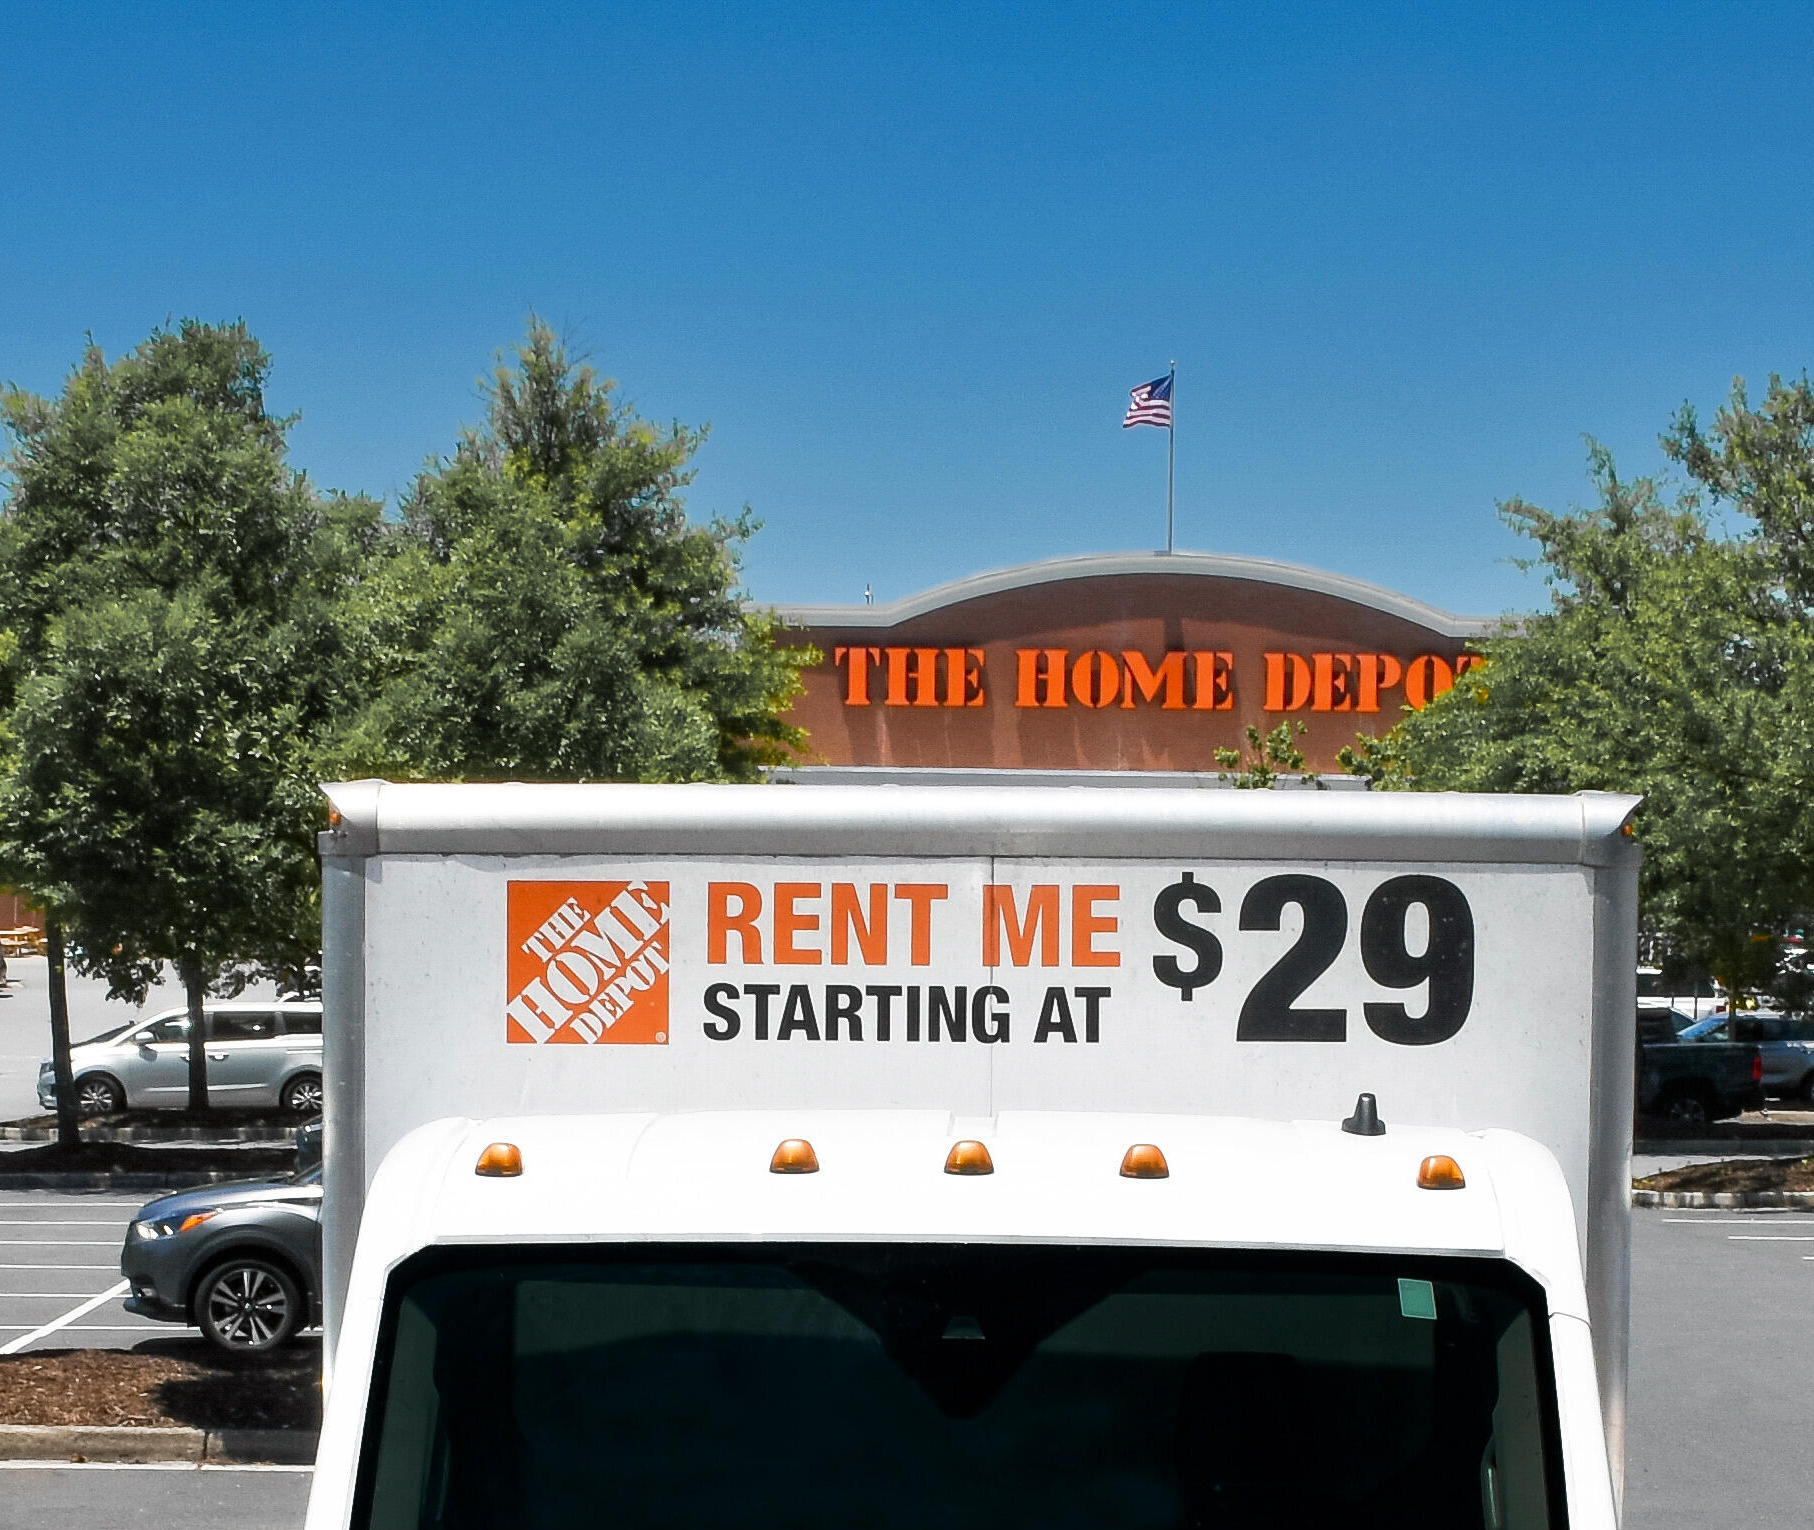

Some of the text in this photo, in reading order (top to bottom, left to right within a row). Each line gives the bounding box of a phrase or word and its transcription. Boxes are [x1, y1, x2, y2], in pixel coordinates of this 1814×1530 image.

[834, 646, 986, 708] THE
[1014, 648, 1234, 711] HOME
[506, 881, 670, 1044] HOME
[521, 897, 592, 963] THE
[706, 882, 1121, 968] RENT ME
[1152, 871, 1475, 1046] $29
[570, 940, 670, 1044] DEPOT
[702, 982, 1112, 1044] STARTING AT
